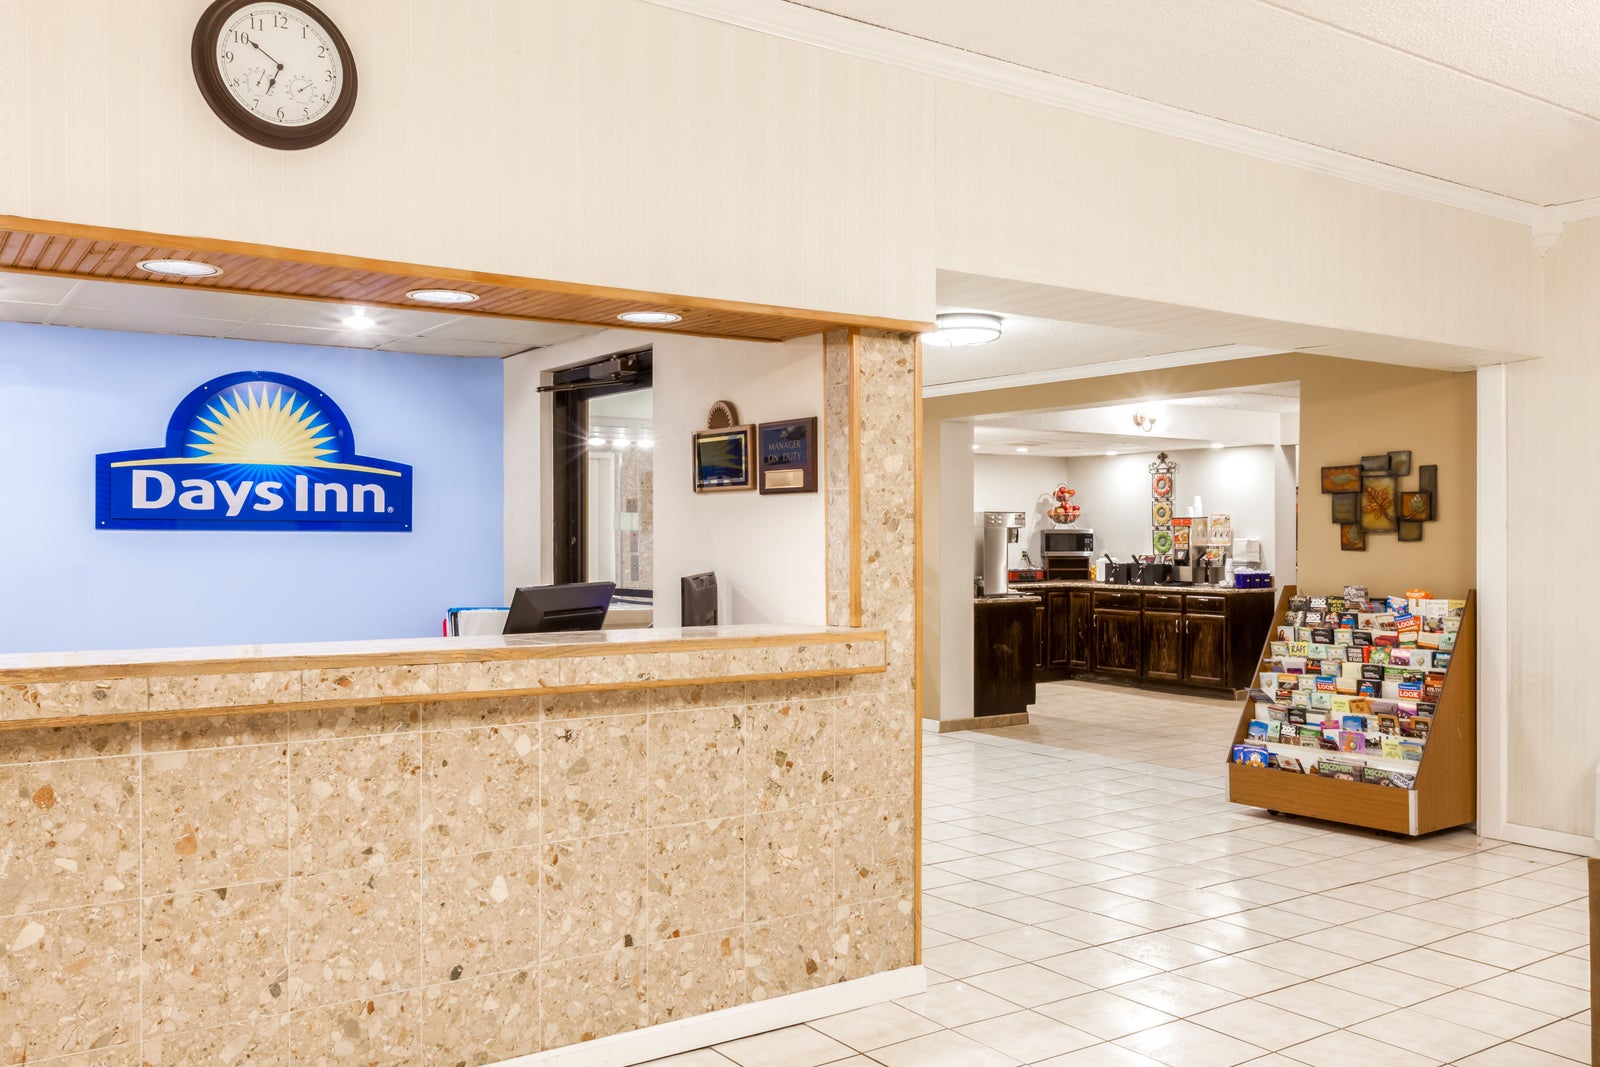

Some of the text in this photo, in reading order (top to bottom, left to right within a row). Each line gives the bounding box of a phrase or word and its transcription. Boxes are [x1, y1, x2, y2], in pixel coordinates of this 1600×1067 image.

[250, 18, 263, 31] 11
[274, 16, 288, 30] 12
[234, 30, 249, 45] 10
[302, 27, 306, 39] 1
[226, 52, 234, 63] 9
[318, 46, 325, 58] 2
[325, 70, 332, 82] 3
[234, 78, 240, 87] 8
[253, 99, 259, 108] 7
[320, 94, 326, 103] 4
[276, 107, 284, 119] 6
[303, 108, 308, 116] 5
[768, 440, 800, 450] MANAGER
[768, 452, 800, 463] ON DUTY
[132, 469, 386, 517] Days Inn
[1397, 620, 1415, 628] LOOK
[1281, 724, 1296, 733] ZOO
[1320, 762, 1352, 773] DISCOVERY
[1364, 768, 1392, 778] DISCOVE
